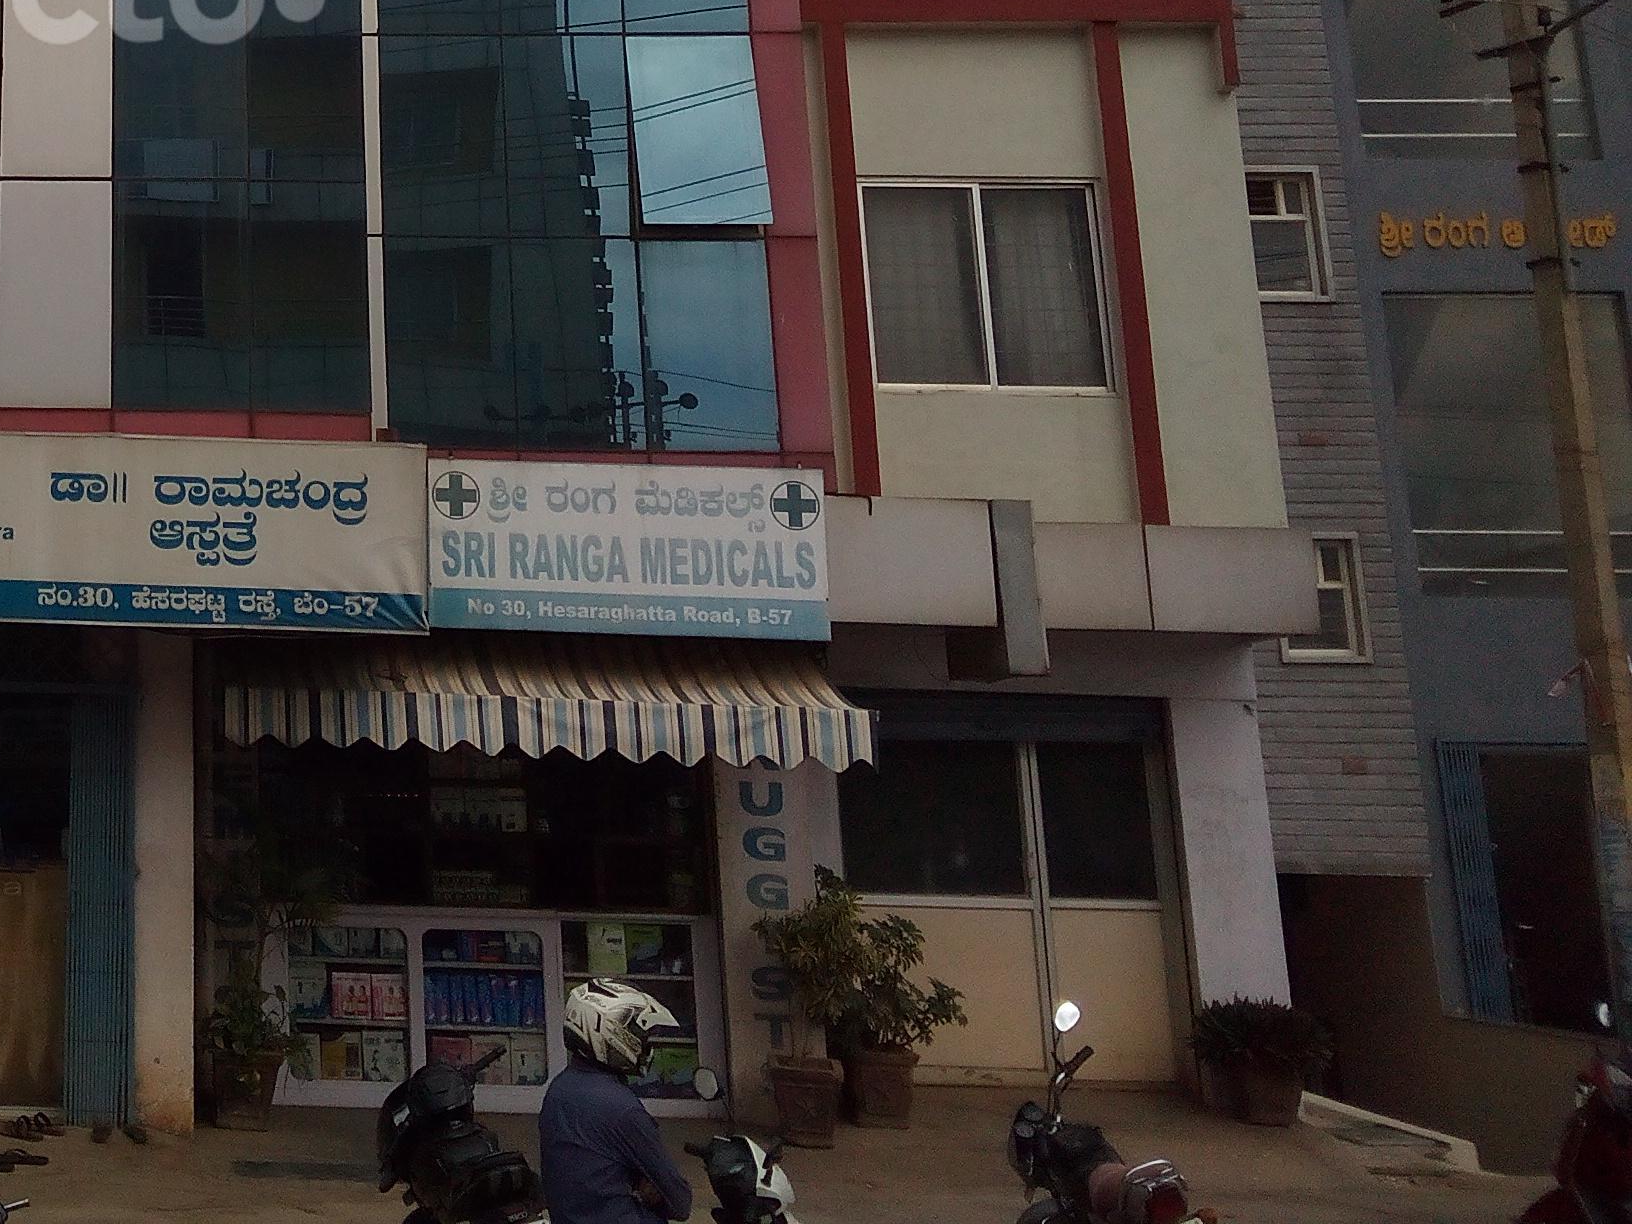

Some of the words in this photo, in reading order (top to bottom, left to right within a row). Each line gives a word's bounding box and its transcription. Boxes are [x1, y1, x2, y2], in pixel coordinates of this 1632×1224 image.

[1423, 210, 1489, 248] ರಂಗ
[153, 468, 369, 526] ರಾಮಚಂದ್ರ
[486, 477, 529, 524] ಶ್ರೀ
[544, 477, 617, 515] ರಂಗ
[149, 511, 258, 567] ಆಸ್ಪತ್ರೆ
[441, 529, 496, 578] SRI
[508, 532, 629, 583] RANGA
[639, 536, 818, 590] MEDICALS
[467, 598, 495, 616] No
[501, 599, 532, 620] 30,
[538, 600, 676, 624] Hesaraghatta
[683, 606, 741, 628] Road,
[747, 608, 793, 626] B-57
